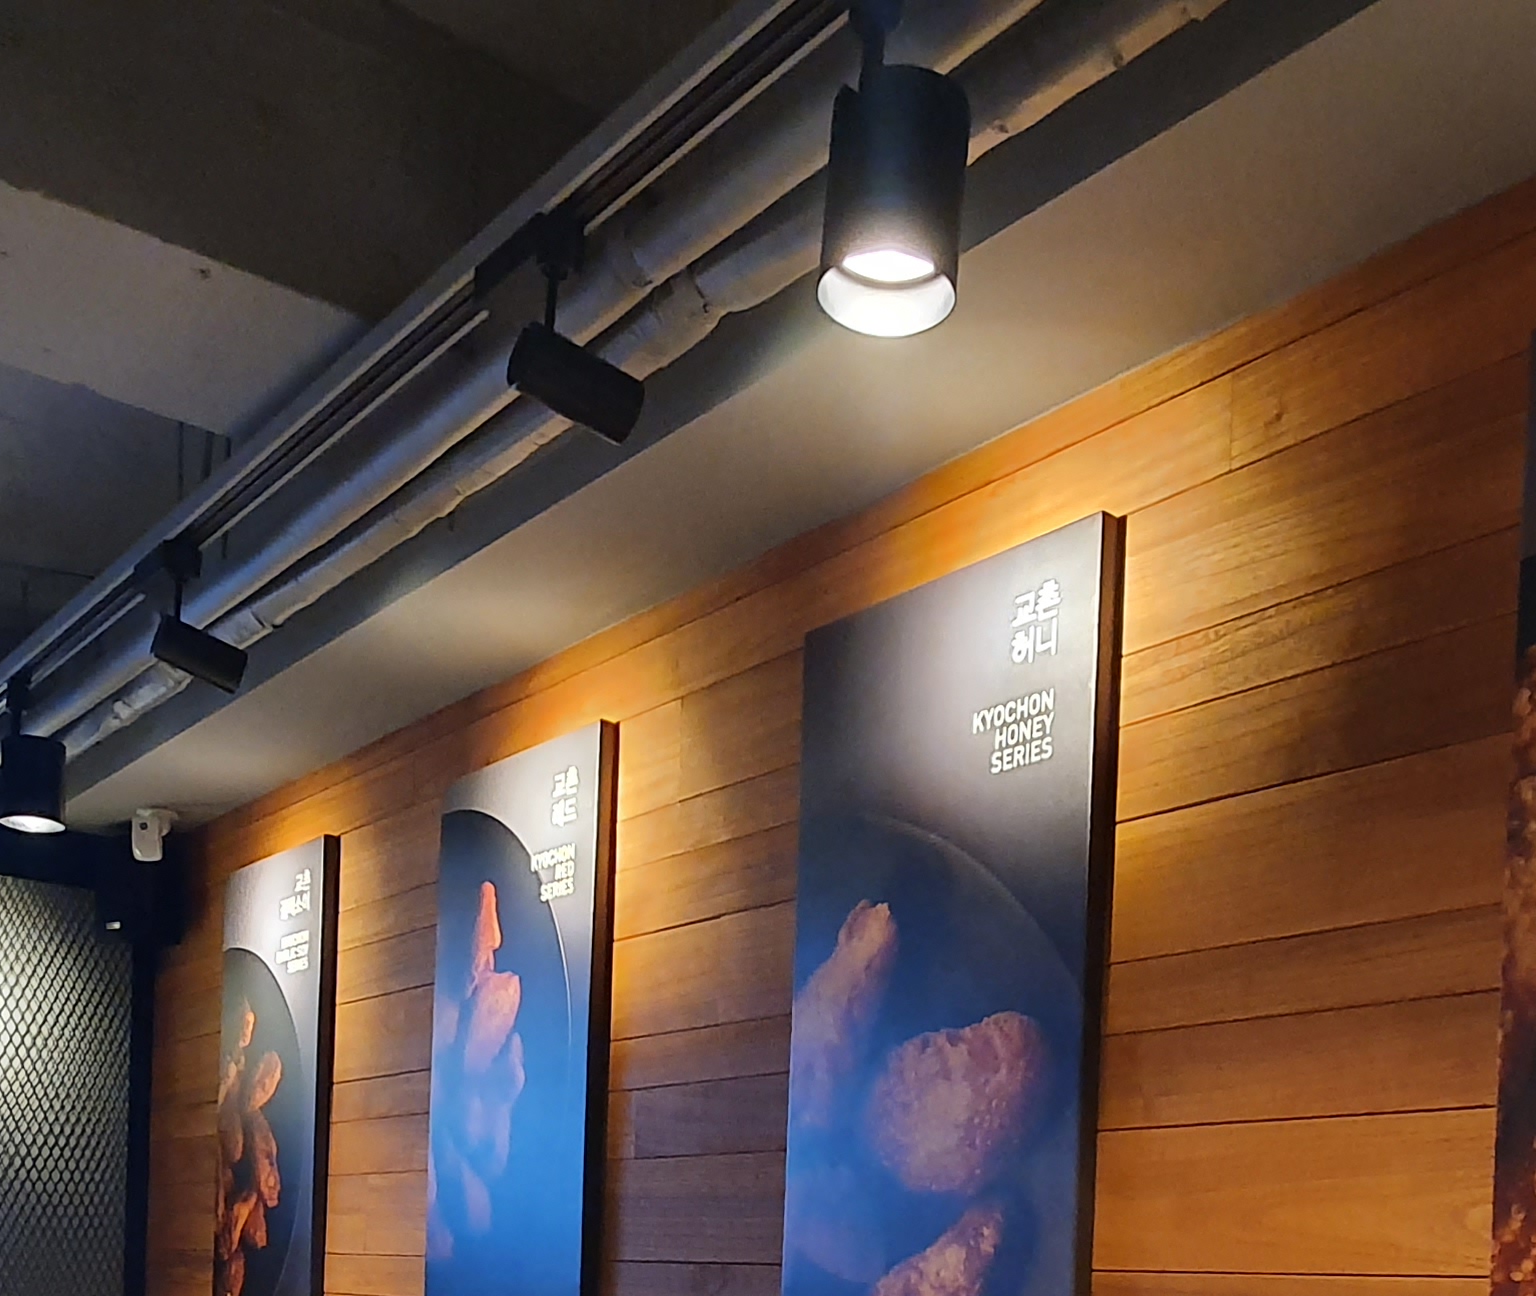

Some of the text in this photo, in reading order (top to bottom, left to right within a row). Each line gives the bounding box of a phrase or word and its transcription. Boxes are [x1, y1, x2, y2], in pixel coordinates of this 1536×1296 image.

[1011, 578, 1063, 628] 교촌
[1011, 617, 1059, 664] 허니
[972, 687, 1055, 734] KYOCHON
[994, 712, 1055, 750] HONEY
[989, 736, 1054, 774] SERIES
[530, 843, 576, 872] KYOCHON
[540, 877, 575, 902] SERIES
